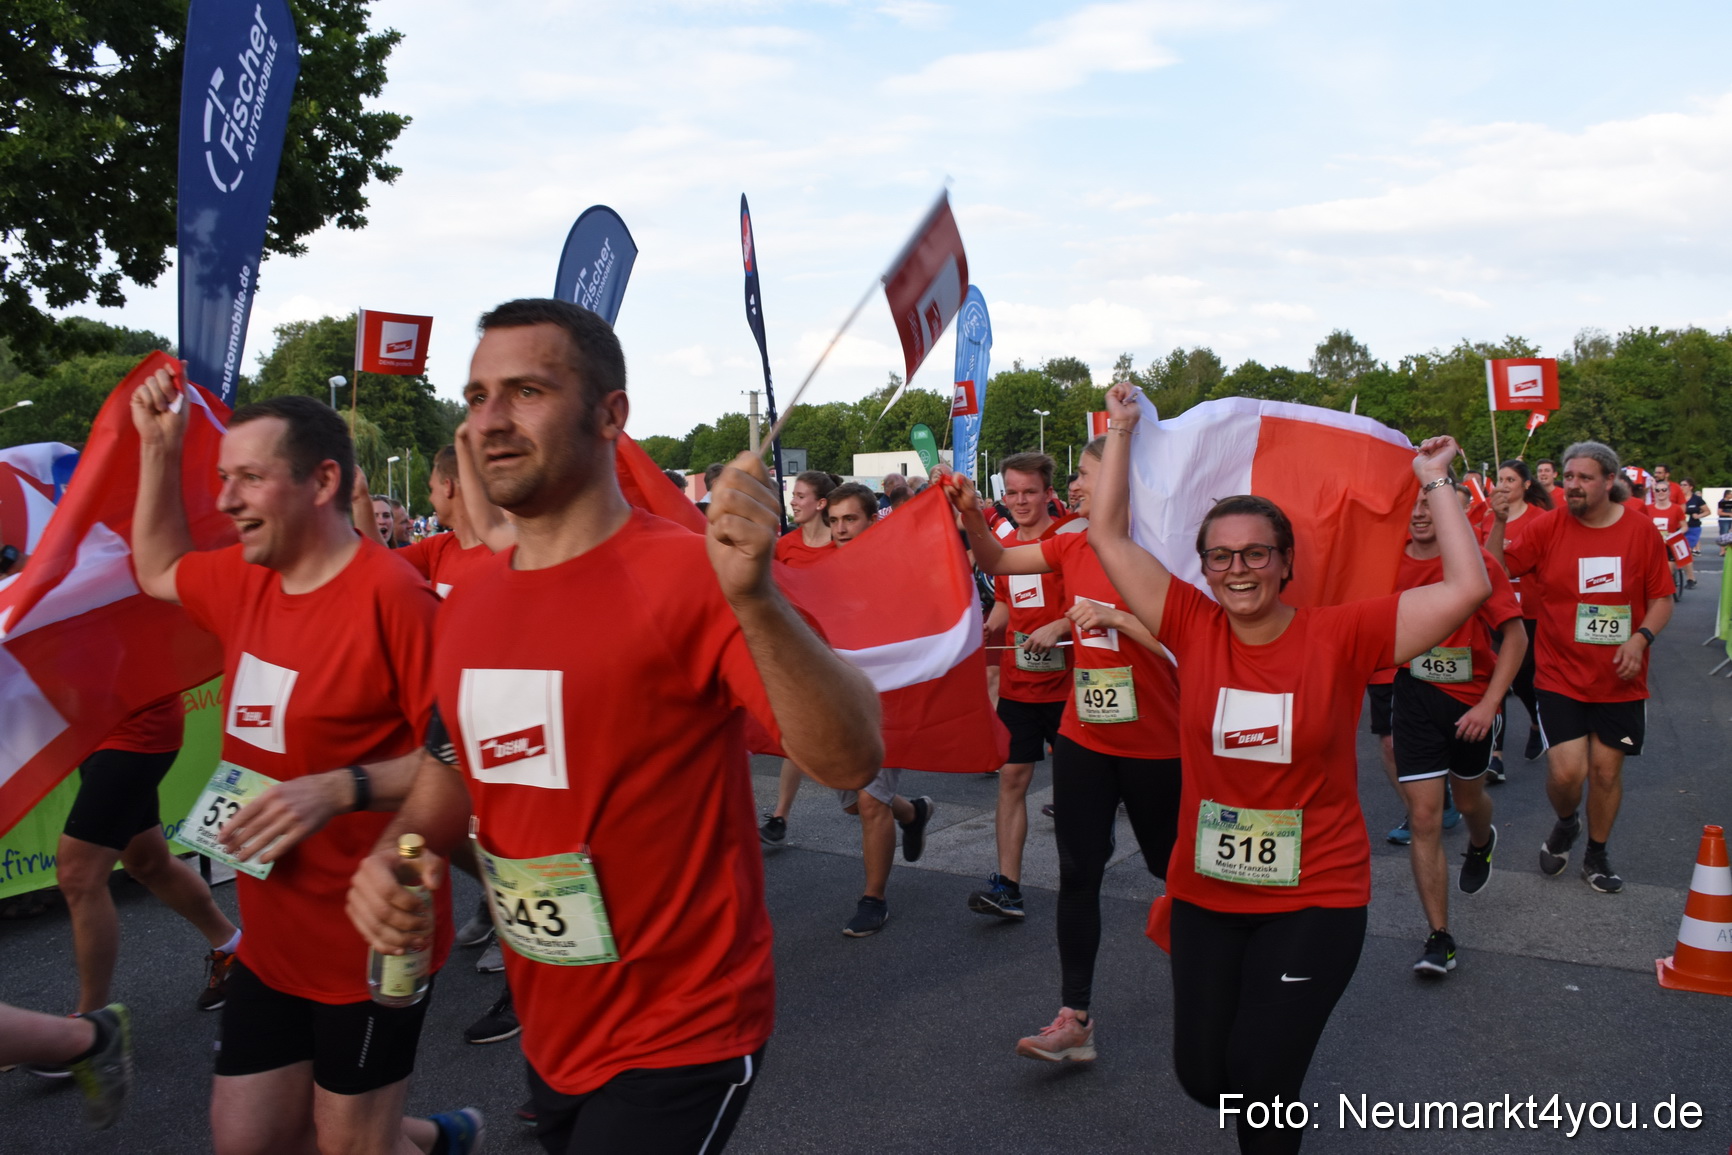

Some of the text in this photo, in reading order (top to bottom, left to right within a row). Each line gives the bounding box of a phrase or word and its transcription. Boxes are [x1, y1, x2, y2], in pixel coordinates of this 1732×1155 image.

[220, 3, 268, 164] Fischer
[245, 35, 278, 161] AUTOMOBILE
[581, 237, 611, 310] Fischer
[592, 251, 616, 312] AUTOMOBILE
[1587, 619, 1619, 634] 479
[1023, 648, 1052, 662] 532
[1422, 658, 1457, 673] 463
[1084, 688, 1118, 708] 492
[494, 738, 529, 758] DEHN
[1238, 732, 1265, 744] DEHN
[203, 795, 242, 828] 53
[1217, 833, 1276, 864] 518
[1216, 859, 1278, 873] Meier Franziska
[495, 890, 566, 937] 543
